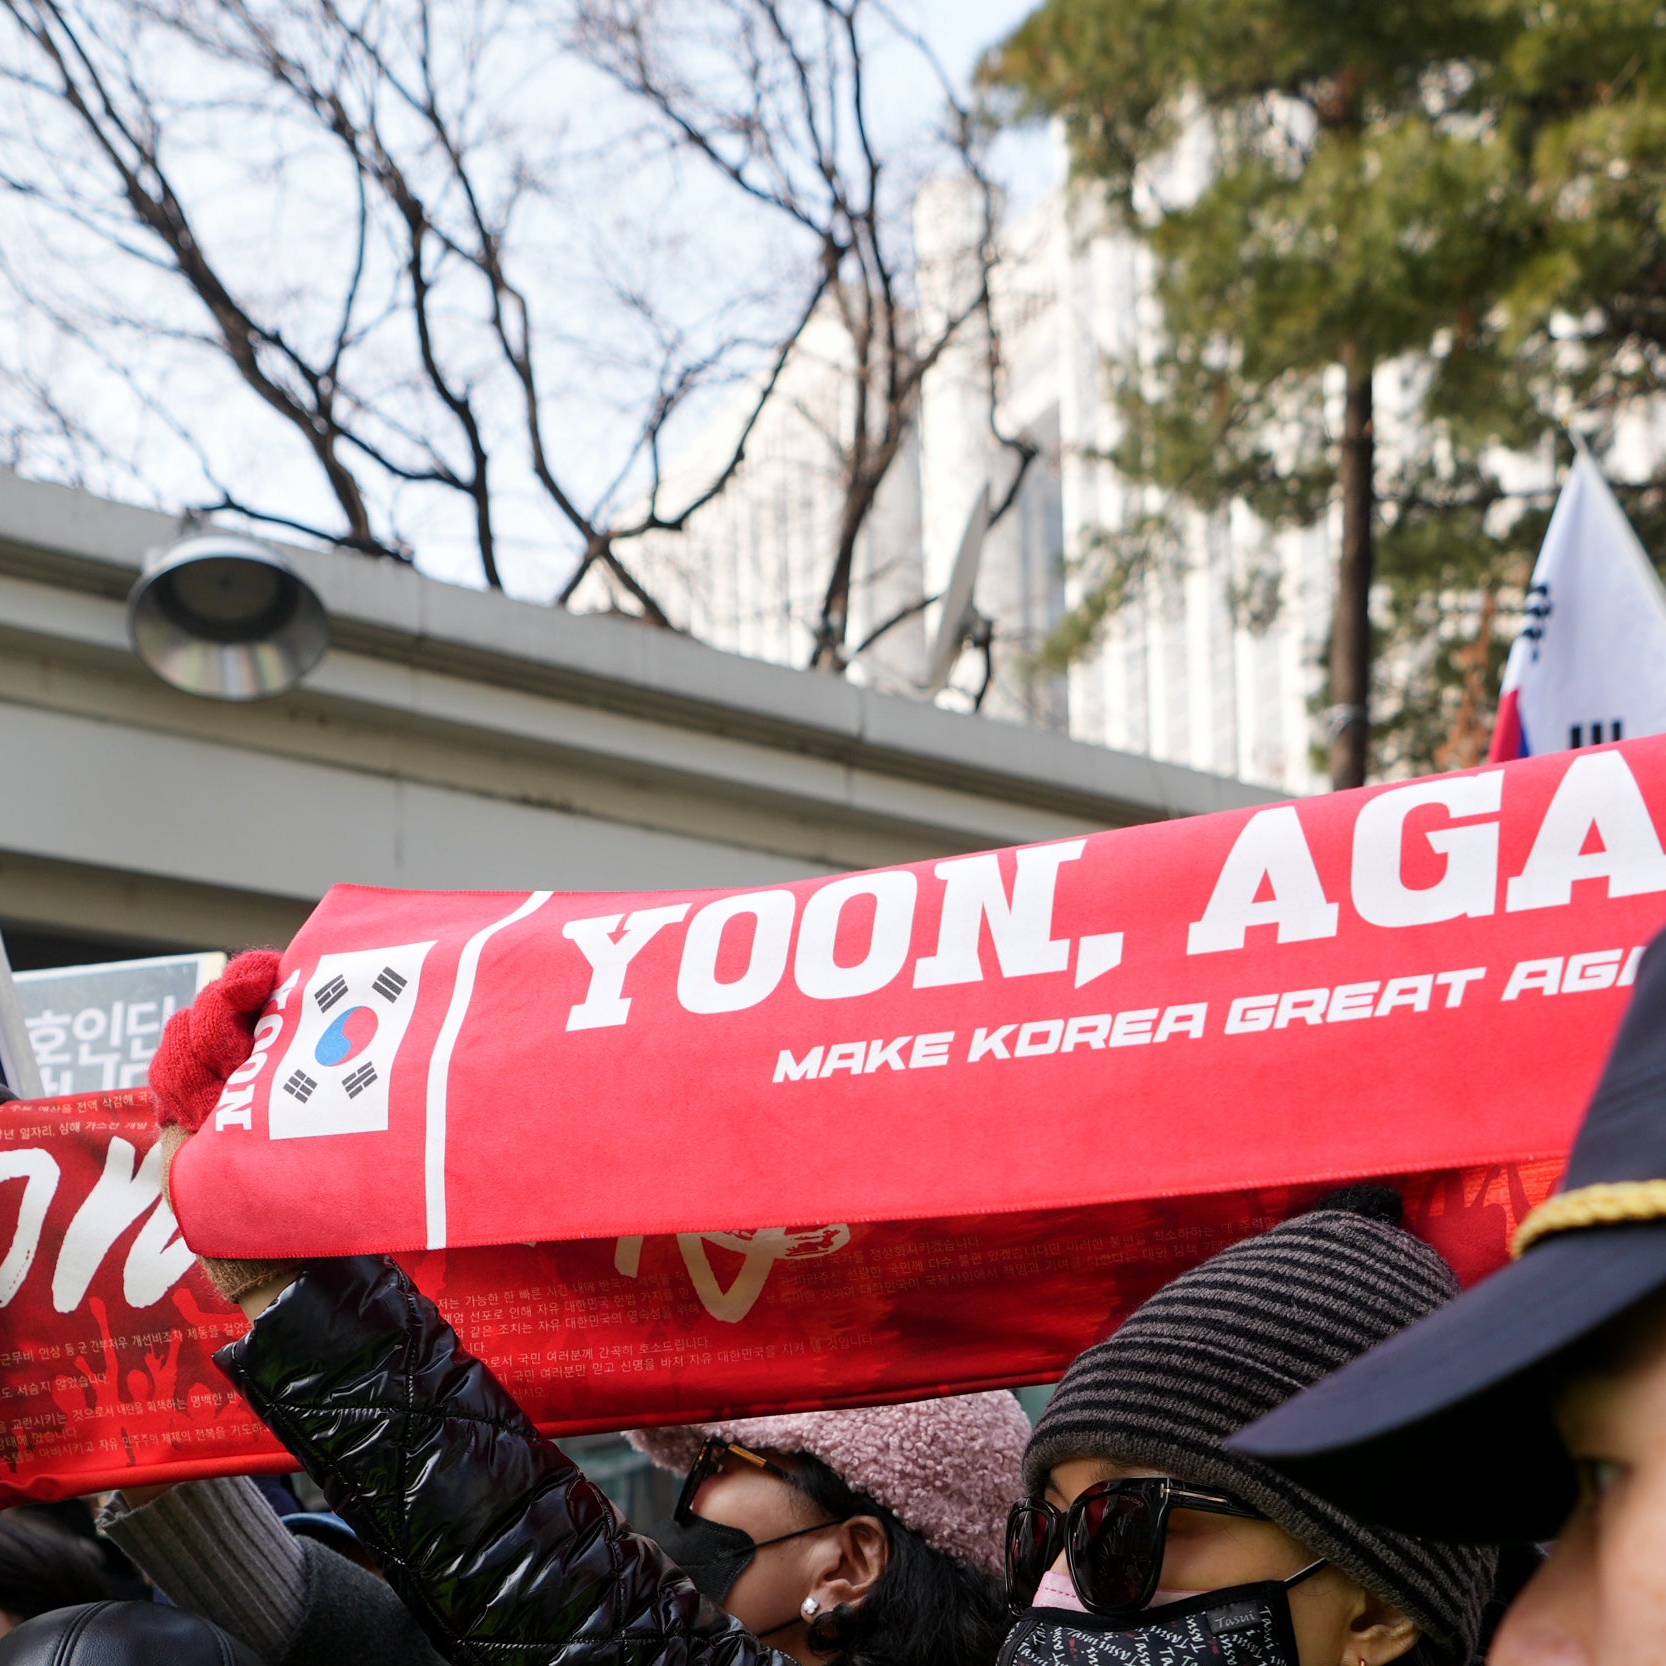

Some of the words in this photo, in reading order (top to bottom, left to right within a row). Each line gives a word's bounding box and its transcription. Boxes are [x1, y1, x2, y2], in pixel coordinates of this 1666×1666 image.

[564, 839, 1124, 1032] YOON,
[772, 1030, 951, 1083] MAKE
[966, 1000, 1206, 1062] KOREA
[1224, 966, 1488, 1035] GREAT
[465, 1293, 499, 1307] 가능한
[469, 1309, 505, 1323] 선포로
[509, 1306, 532, 1319] 인해
[537, 1303, 560, 1316] 자유
[564, 1296, 610, 1312] 대한민국
[470, 1326, 493, 1338] 같은
[499, 1323, 533, 1335] 조치는
[538, 1319, 561, 1332] 자유
[565, 1311, 623, 1328] 대한민국의
[0, 1350, 34, 1366] 근무비
[518, 1353, 541, 1365] 국민
[547, 1347, 593, 1362] 여러분께
[540, 1365, 587, 1379] 여러분만
[592, 1362, 615, 1375] 믿고
[621, 1358, 655, 1373] 신명을
[689, 1354, 712, 1365] 자유
[13, 1412, 69, 1430] 교란시키는
[1215, 1610, 1255, 1629] Tasui
